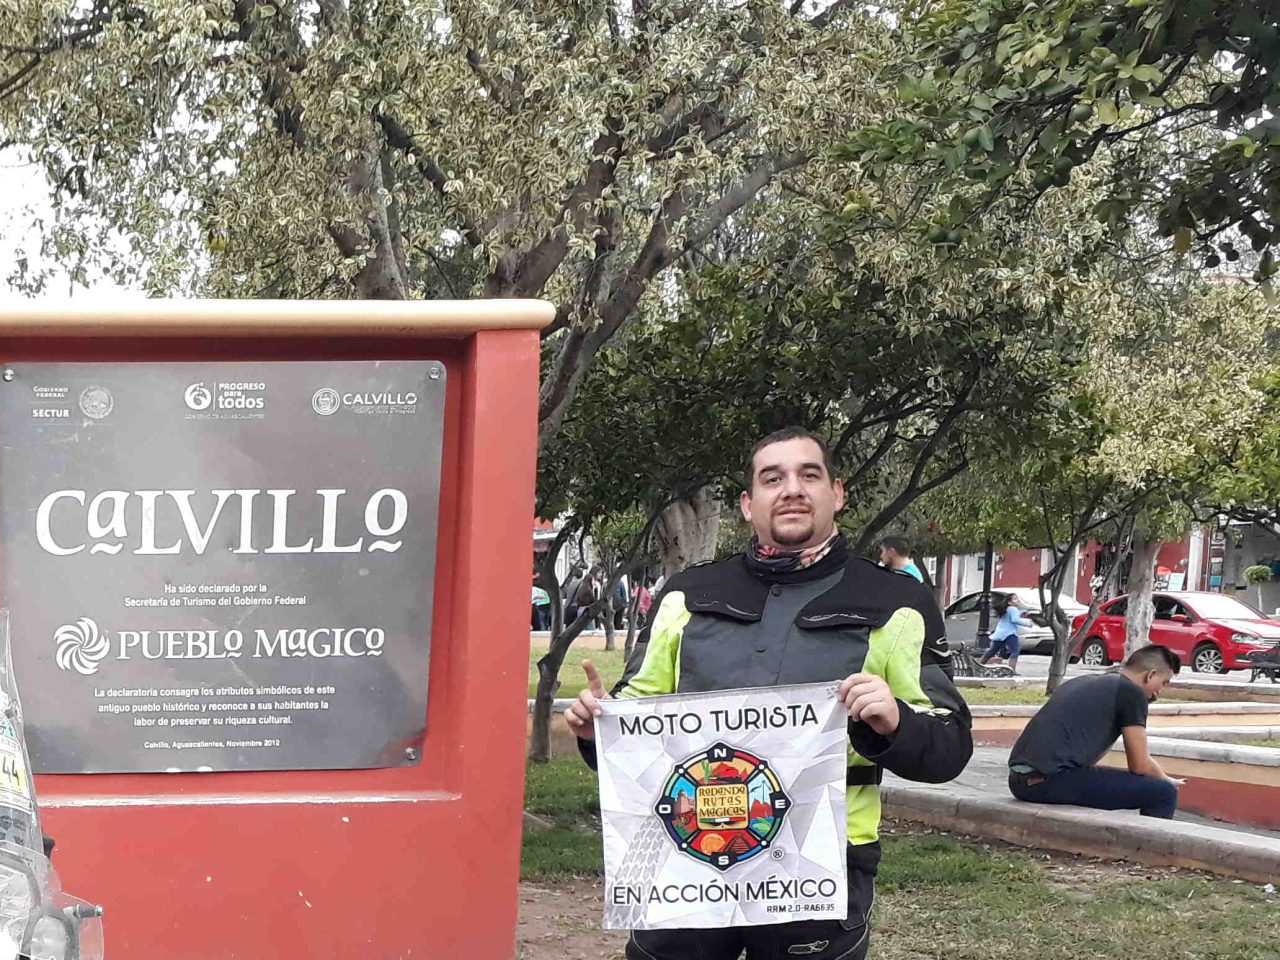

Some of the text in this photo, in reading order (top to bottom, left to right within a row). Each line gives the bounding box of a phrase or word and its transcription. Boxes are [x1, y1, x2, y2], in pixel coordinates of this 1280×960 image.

[218, 382, 266, 391] PROGRESO
[217, 394, 265, 409] todos
[342, 392, 418, 405] CALVILLO
[32, 409, 70, 418] SECTUR
[164, 583, 268, 593] Ha sido declarado por la
[170, 597, 181, 606] de
[183, 596, 217, 606] Turismo
[218, 596, 232, 606] del
[233, 596, 273, 606] Gobierno
[274, 595, 307, 605] Federal
[94, 684, 336, 699] La declaratoria consagra los atributos simbólicos de este
[98, 703, 130, 714] antiguo
[132, 702, 161, 714] pueblo
[162, 701, 200, 712] histórico
[201, 703, 207, 713] y
[208, 703, 248, 711] reconoce
[257, 702, 272, 710] sus
[274, 700, 319, 710] habitantes
[320, 700, 329, 709] la
[133, 714, 293, 728] labor de preservar su riqueza cultural.
[620, 703, 819, 735] MOTO TURISTA
[144, 740, 170, 750] Calvillo,
[226, 739, 263, 748] Noviembre
[263, 738, 280, 747] 2012
[714, 748, 727, 759] N
[774, 799, 786, 808] E
[718, 855, 730, 865] S
[613, 875, 837, 905] EN ACCIÓN MÉXICO
[767, 905, 787, 913] RRM
